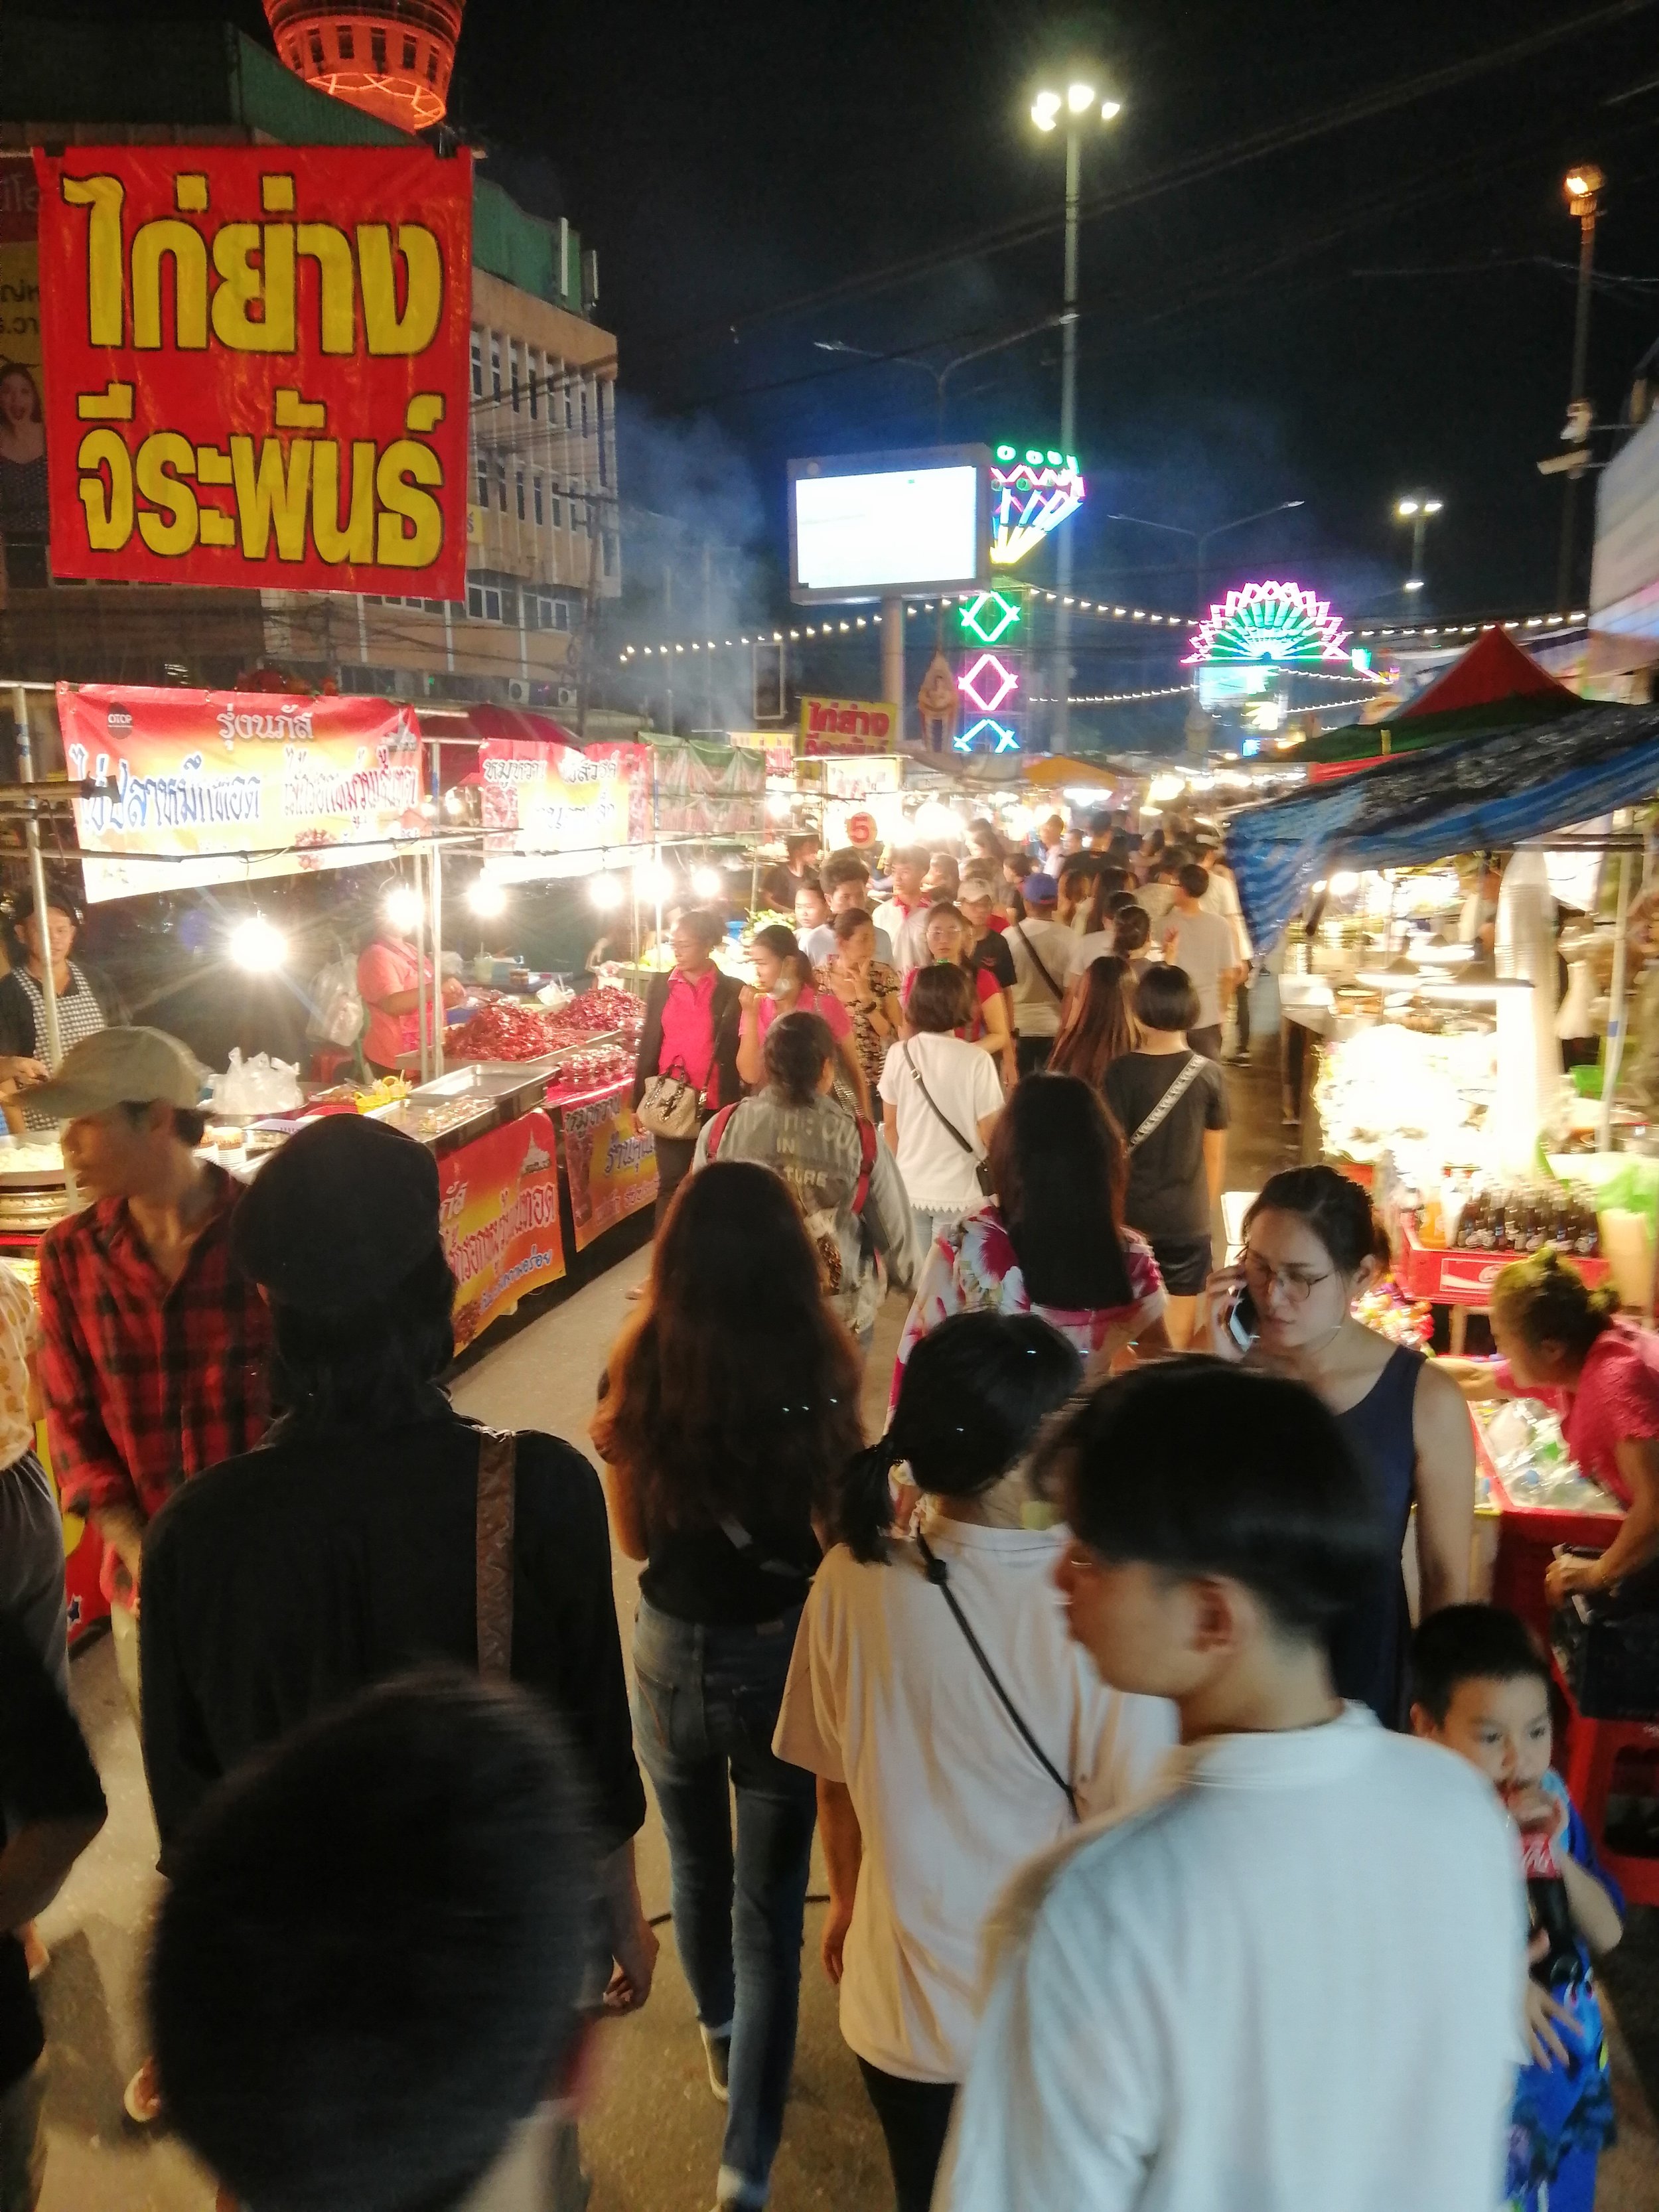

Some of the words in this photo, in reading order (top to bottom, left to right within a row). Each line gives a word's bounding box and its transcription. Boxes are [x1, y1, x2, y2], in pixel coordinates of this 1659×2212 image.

[61, 172, 447, 356] ไก่ย่าง
[76, 382, 447, 569] จีระพันธ์
[108, 713, 132, 724] OTOP
[216, 703, 315, 751] รุ่งนภัส
[849, 816, 871, 844] 5
[783, 1166, 829, 1188] TURE
